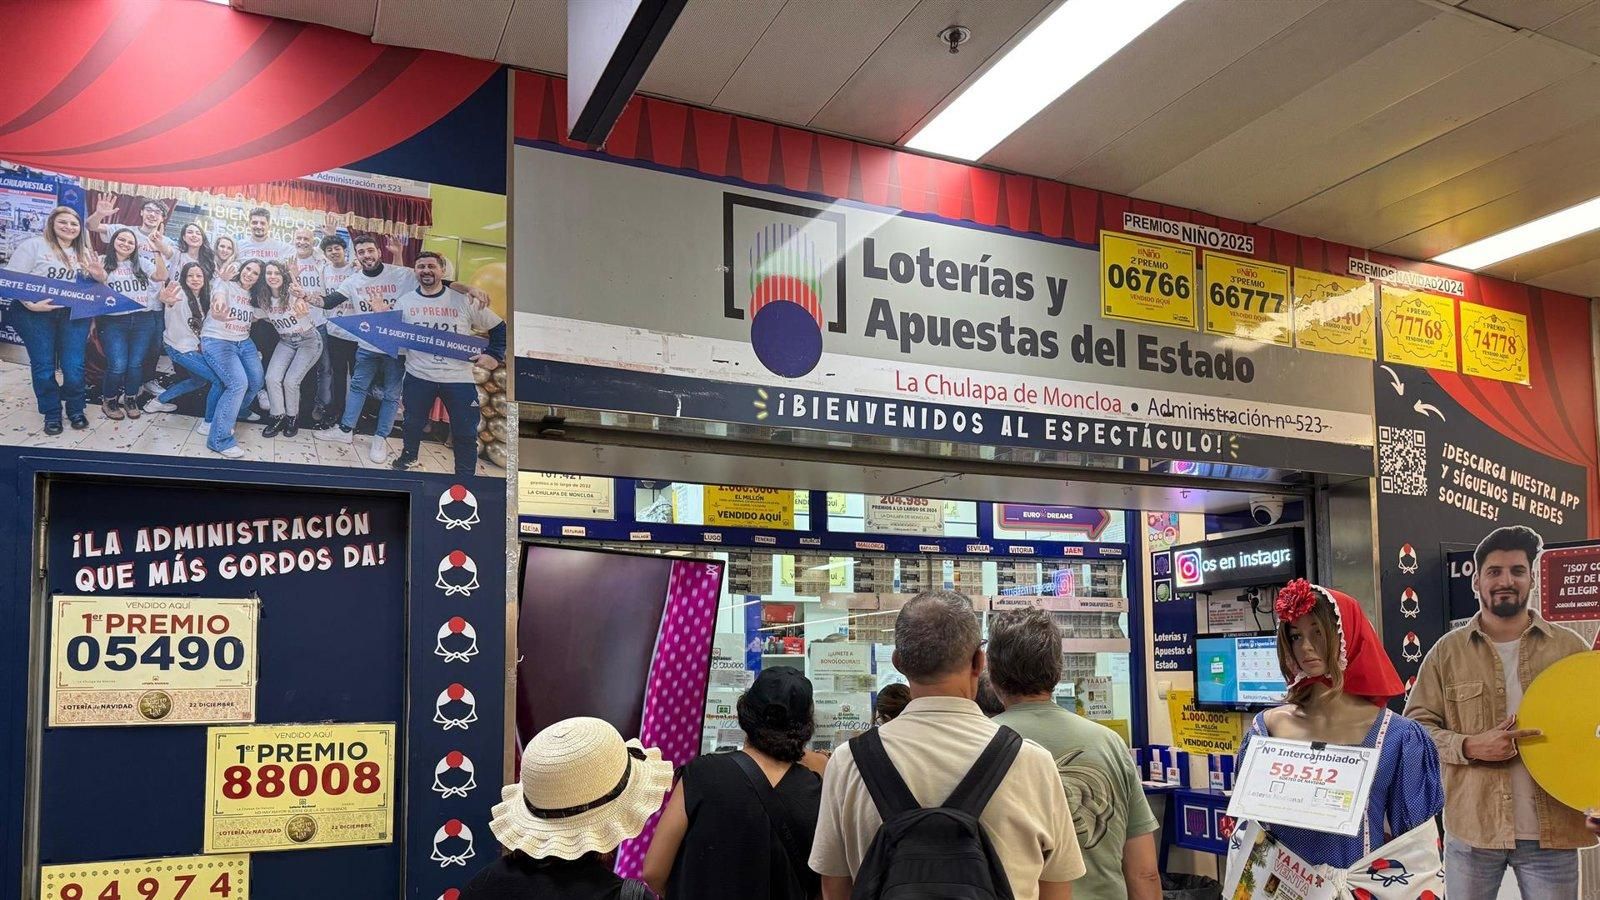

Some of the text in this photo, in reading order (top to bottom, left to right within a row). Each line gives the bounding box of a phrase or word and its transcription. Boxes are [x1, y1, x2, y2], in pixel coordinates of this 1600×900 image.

[388, 184, 402, 192] 523
[1124, 213, 1254, 252] PREMIOS NIÑO 2025
[1138, 258, 1168, 270] PREMIO
[863, 238, 1068, 316] Loterías y
[1108, 264, 1190, 299] 06766
[1237, 277, 1265, 288] PREMIO
[1437, 278, 1464, 294] 2024
[48, 287, 59, 295] EN
[1210, 282, 1284, 313] 66777
[423, 306, 458, 318] PREMIO
[1395, 314, 1442, 340] 77768
[389, 330, 481, 355] SUERTE ESTÁ EN MONCLOA
[864, 297, 1255, 384] Apuestas del Estado
[1473, 330, 1517, 355] 74778
[895, 370, 919, 393] La
[924, 372, 1008, 405] Chulapa
[1014, 381, 1038, 403] de
[1044, 387, 1122, 414] Moncloa
[1148, 397, 1271, 429] Administración
[1296, 413, 1323, 433] 523
[777, 392, 1223, 454] ¡BIENVENIDOS AL ESPECTÁCULO!
[1442, 442, 1580, 510] ¡DESCARGA NUESTRA APP
[1438, 486, 1500, 522] SOCIALES!
[1441, 464, 1564, 526] Y SÍGUENOS EN REDES
[717, 510, 782, 522] VENDIDO AQUÍ
[1047, 512, 1073, 520] DREAMS
[72, 506, 371, 559] ¡LA ADMINISTRACIÓN
[967, 544, 989, 553] SEVILLA
[1065, 546, 1082, 554] JAEN
[75, 542, 387, 593] QUE MÁS GORDOS DA!
[1202, 559, 1217, 572] os
[1220, 556, 1235, 570] en
[1563, 574, 1596, 585] REY DE
[1559, 586, 1598, 596] A ELEGIR
[126, 601, 191, 610] VENDIDO AQUÍ
[106, 613, 230, 634] PREMIO
[1155, 633, 1188, 643] Loterías y
[67, 636, 245, 672] 05490
[1155, 646, 1186, 657] Apuestas
[1155, 660, 1178, 669] Estado
[312, 731, 333, 739] AQUÍ
[1183, 737, 1233, 751] VENDIDO AQUÍ
[257, 741, 368, 763] PREMIO
[1278, 748, 1361, 765] Intercambiador
[222, 761, 381, 800] 88008
[1269, 761, 1338, 784] 59.512
[1274, 859, 1310, 896] VENTA
